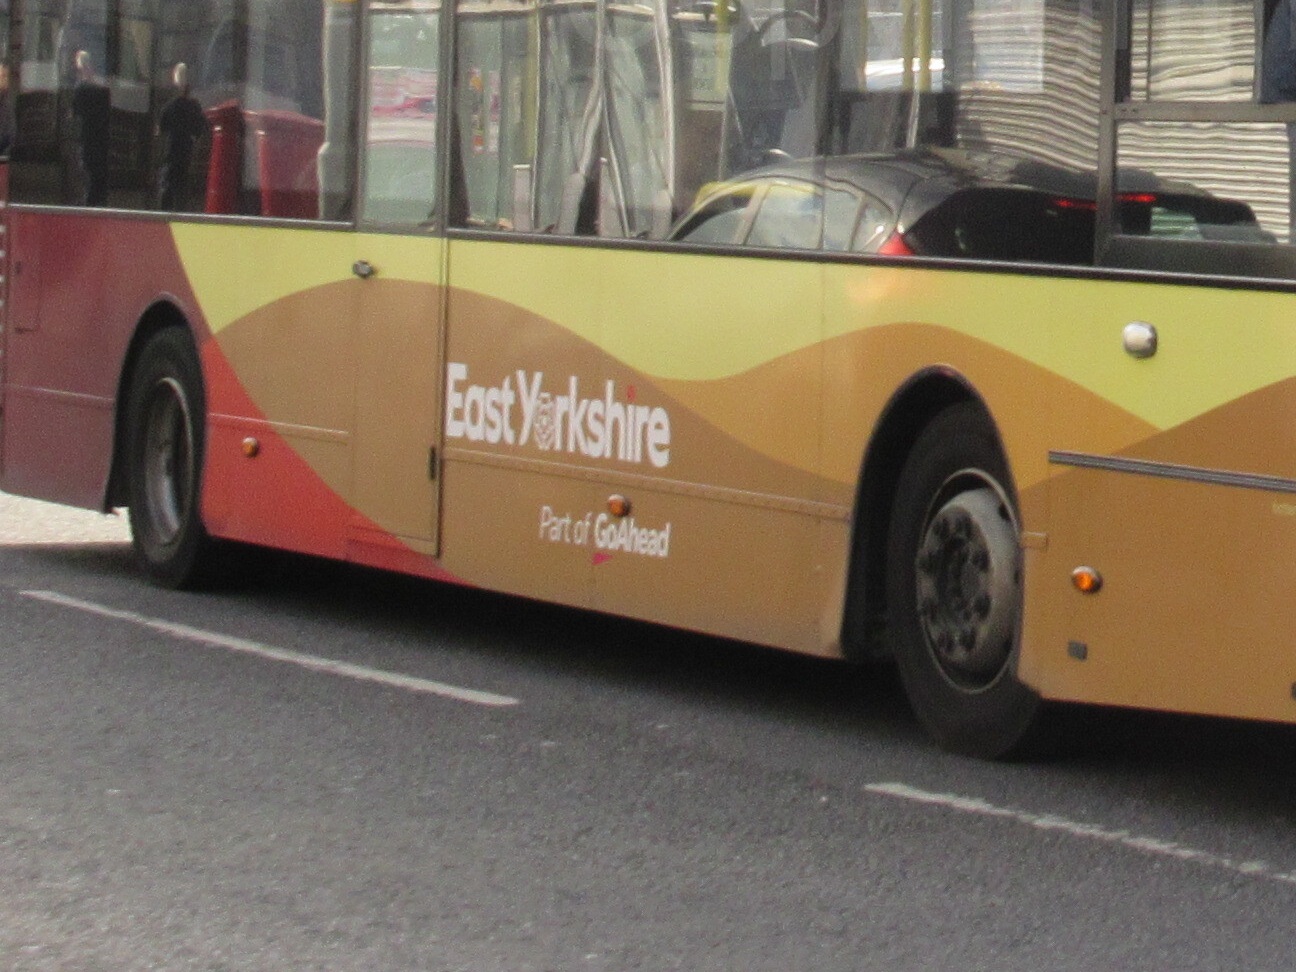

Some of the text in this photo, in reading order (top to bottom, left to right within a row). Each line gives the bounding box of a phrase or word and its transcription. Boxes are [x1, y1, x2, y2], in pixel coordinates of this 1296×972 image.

[446, 361, 671, 468] East Yorkshire
[539, 505, 572, 544] Part
[573, 511, 593, 546] of
